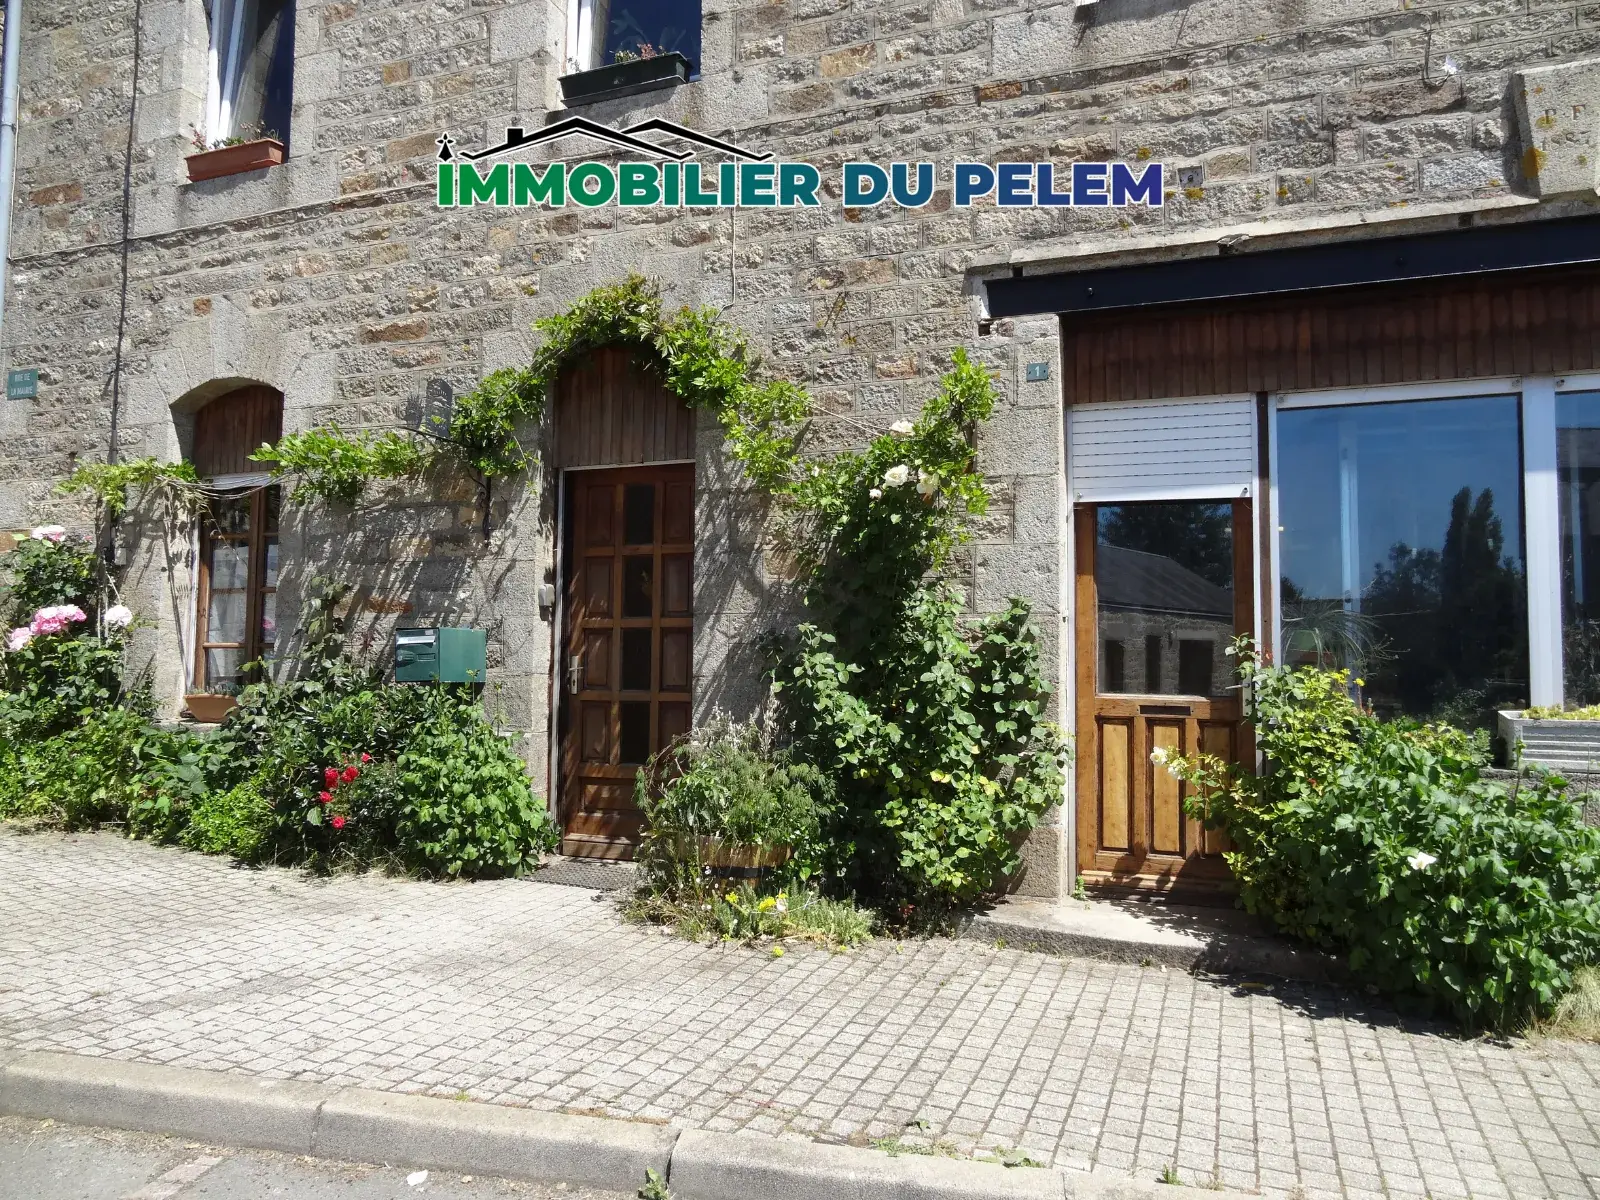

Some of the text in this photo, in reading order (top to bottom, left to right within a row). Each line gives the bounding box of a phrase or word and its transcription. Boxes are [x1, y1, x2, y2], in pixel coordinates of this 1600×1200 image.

[1034, 365, 1041, 377] 1
[14, 374, 24, 382] RUE
[10, 387, 17, 396] LA
